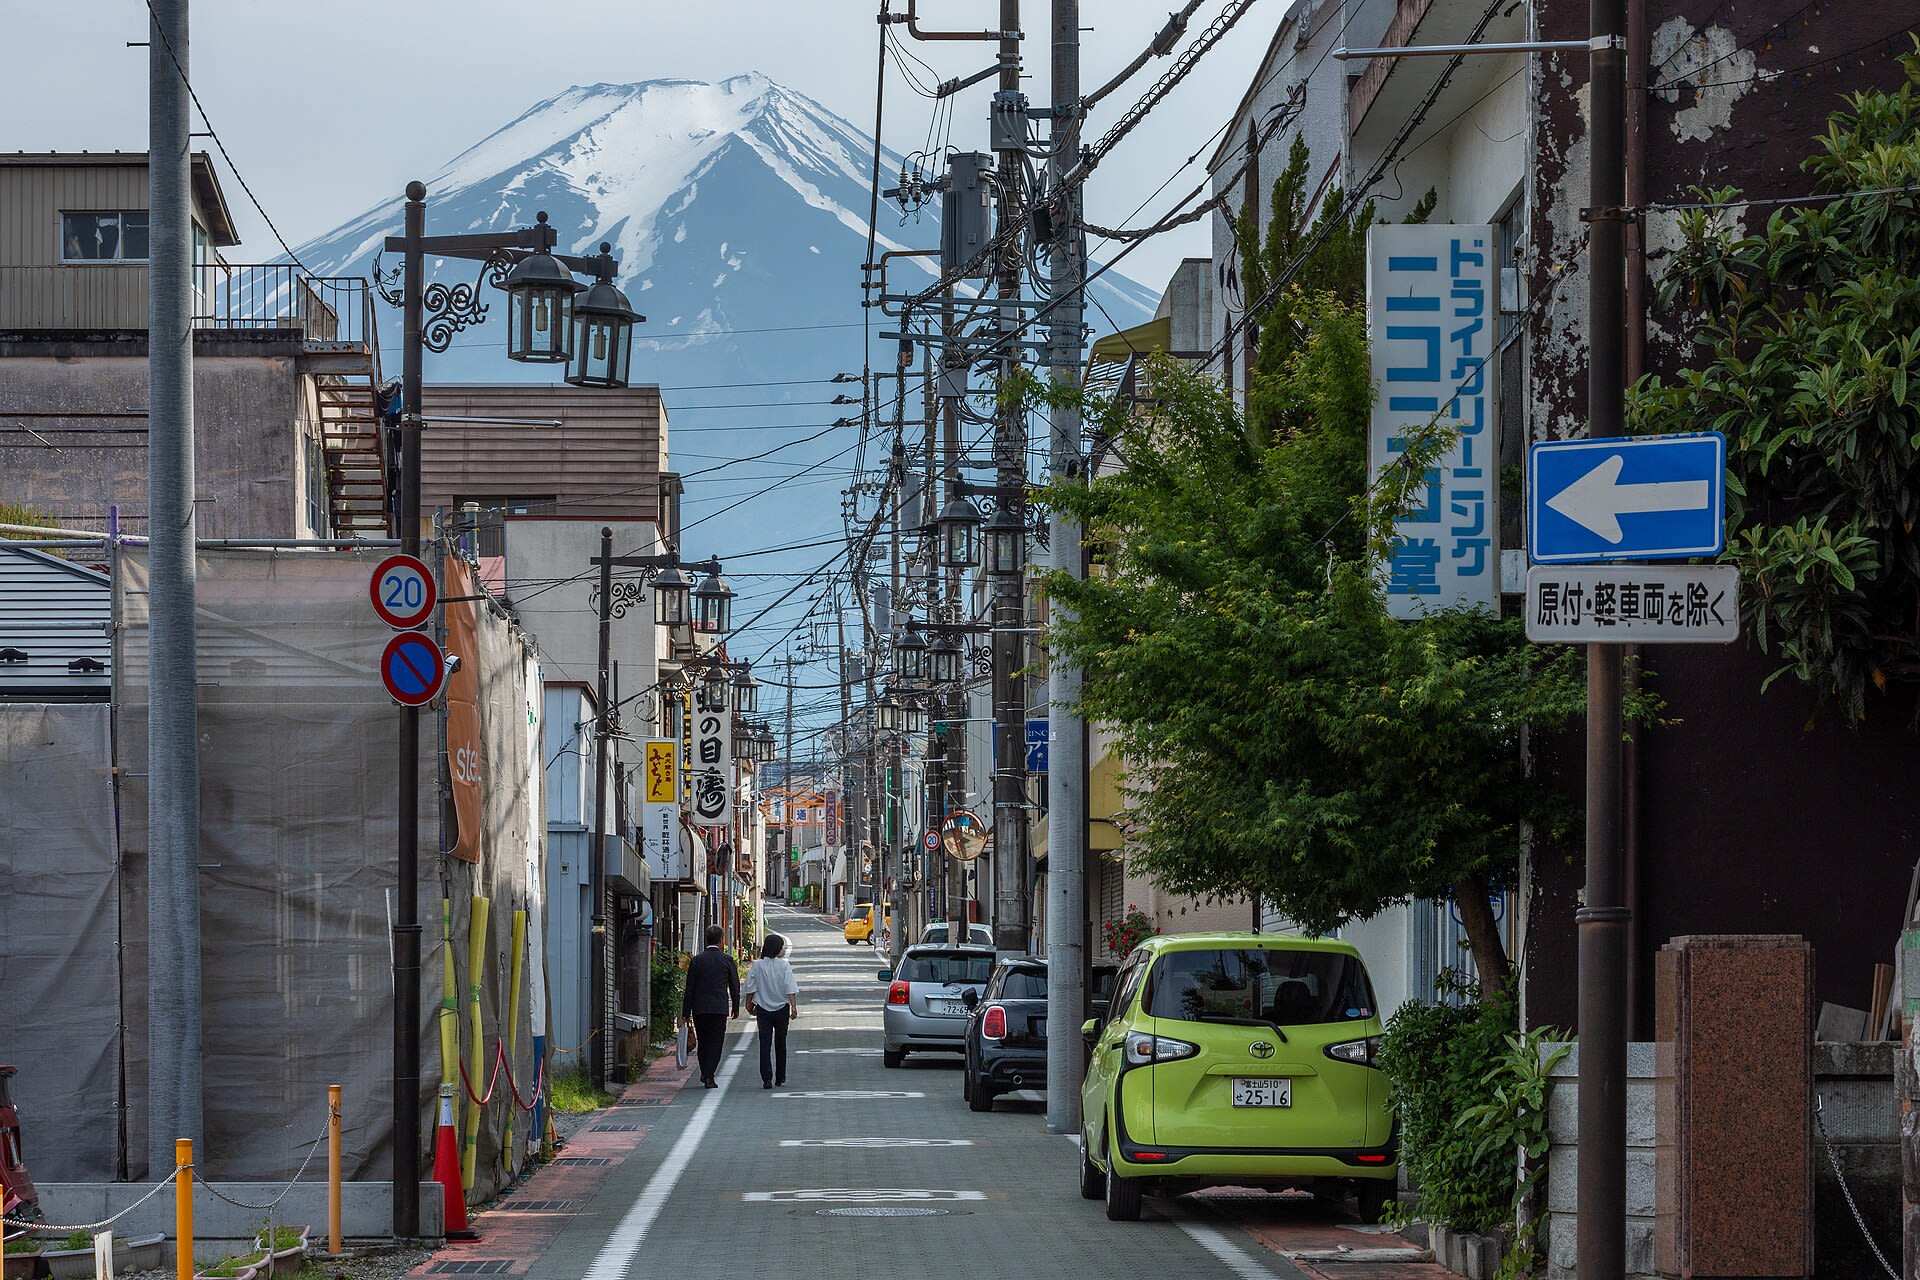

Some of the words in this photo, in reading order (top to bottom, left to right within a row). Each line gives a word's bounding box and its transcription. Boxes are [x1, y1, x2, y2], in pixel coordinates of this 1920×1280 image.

[1450, 239, 1490, 576] ドライクリーニング
[385, 575, 422, 608] 20
[1537, 581, 1725, 628] 原付・軽車両を除く
[927, 835, 937, 845] 20
[1245, 1090, 1288, 1105] 25-16
